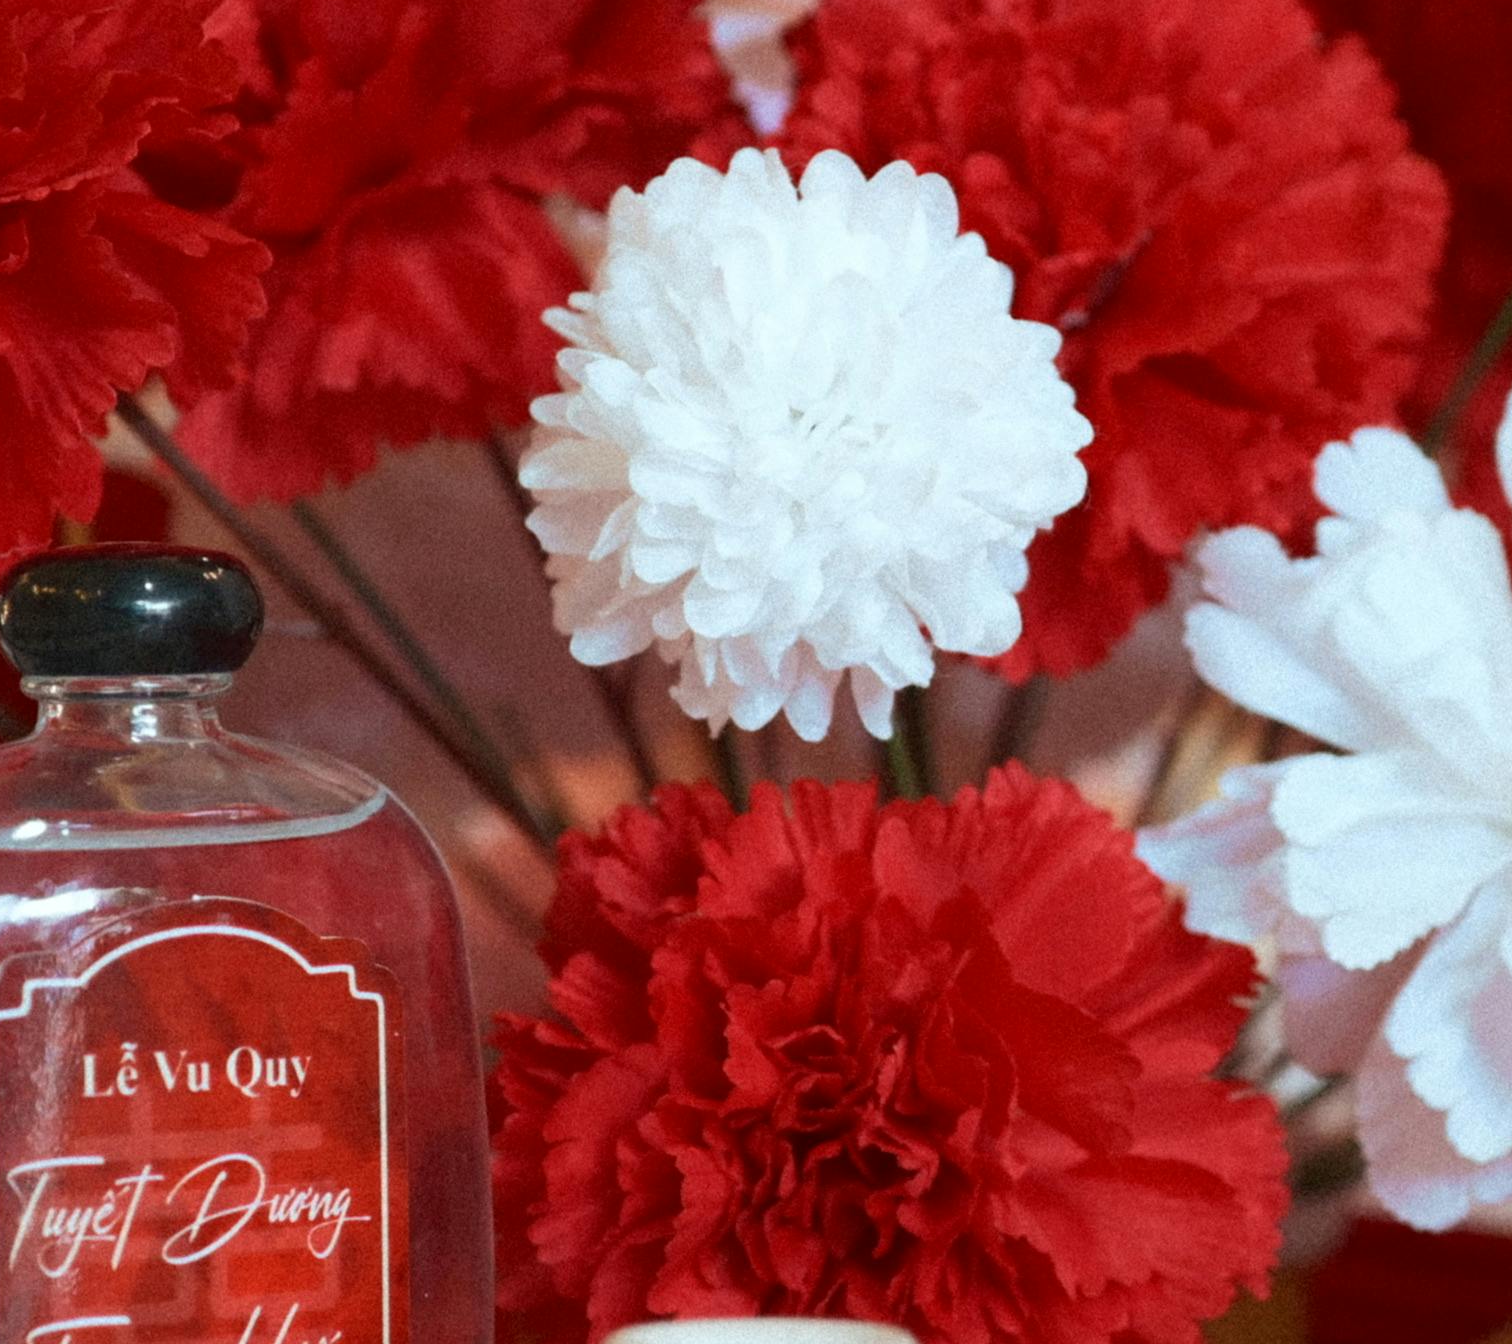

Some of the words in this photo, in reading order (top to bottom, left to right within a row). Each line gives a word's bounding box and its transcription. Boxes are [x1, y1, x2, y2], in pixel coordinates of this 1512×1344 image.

[82, 1041, 139, 1098] Lễ
[153, 1049, 211, 1093] Vu
[225, 1045, 313, 1099] Quy
[5, 1155, 165, 1279] Tuyết
[161, 1152, 373, 1266] Dương
